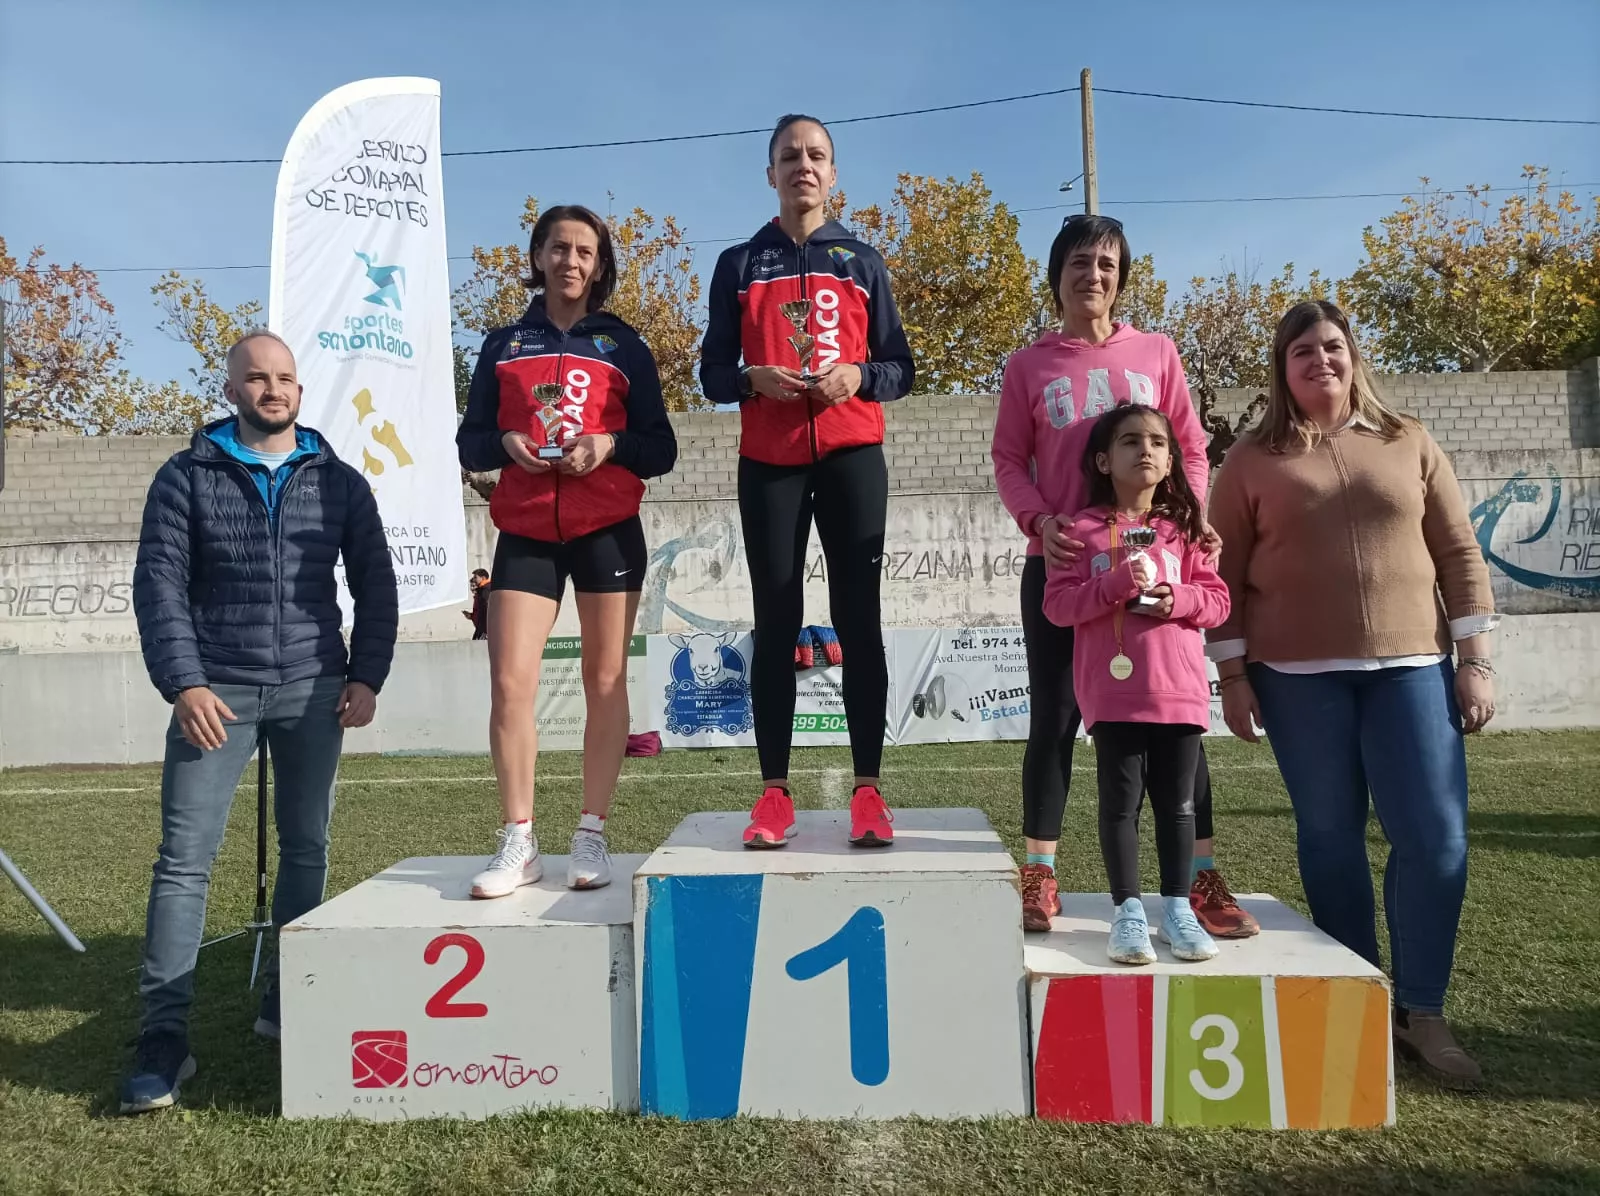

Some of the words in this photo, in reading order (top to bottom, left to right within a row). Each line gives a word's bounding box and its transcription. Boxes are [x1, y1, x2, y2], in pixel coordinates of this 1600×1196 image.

[413, 526, 431, 538] DE
[0, 581, 133, 617] RIEGOS
[951, 638, 977, 649] Tel.
[982, 637, 1008, 649] 974
[979, 700, 1030, 722] Estad
[423, 932, 489, 1018] 2
[784, 905, 890, 1088] 1
[1188, 1013, 1245, 1101] 3
[353, 1095, 407, 1104] GUARA
